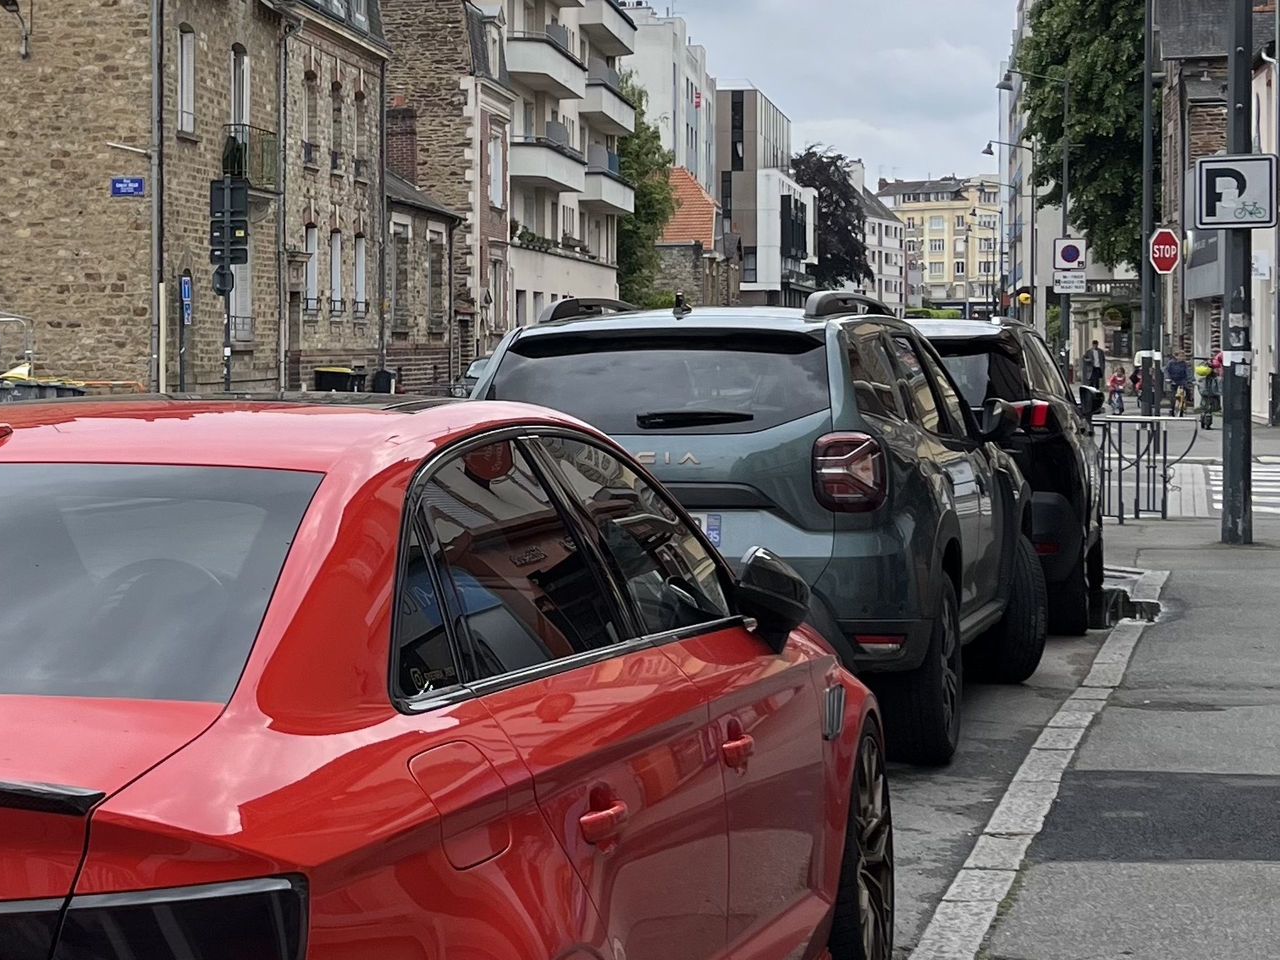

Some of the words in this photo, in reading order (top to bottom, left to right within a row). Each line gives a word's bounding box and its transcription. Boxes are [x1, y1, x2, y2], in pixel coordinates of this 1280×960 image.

[1153, 245, 1177, 258] STOP
[635, 451, 701, 465] CIA
[707, 531, 720, 543] 35
